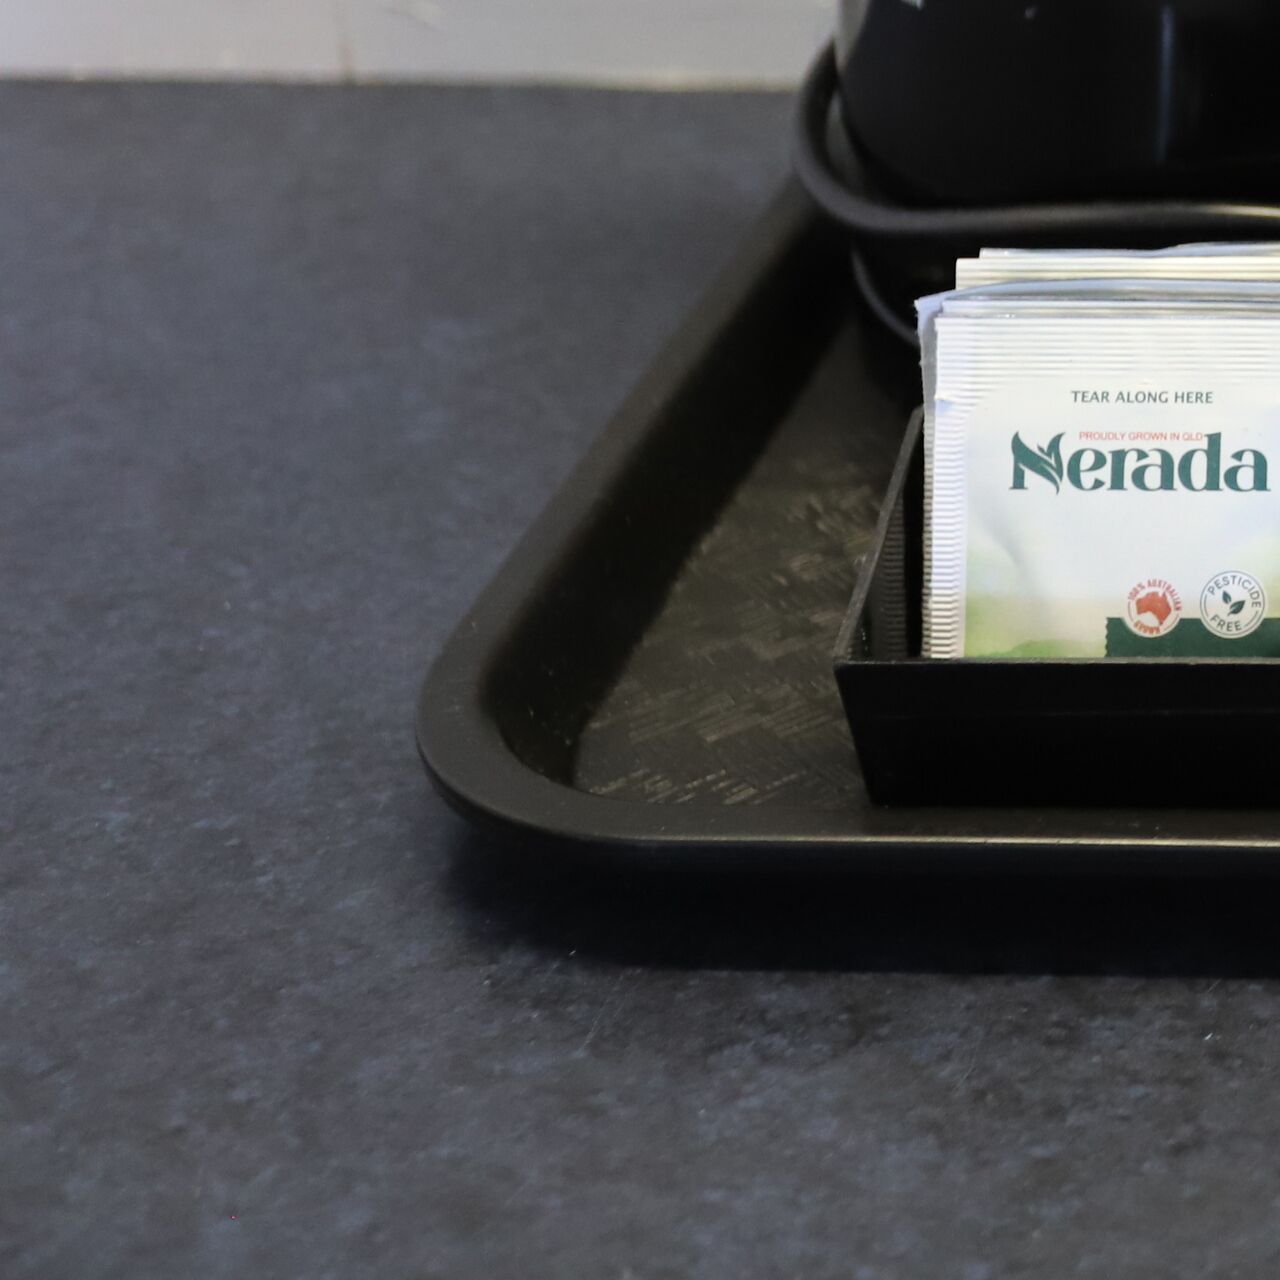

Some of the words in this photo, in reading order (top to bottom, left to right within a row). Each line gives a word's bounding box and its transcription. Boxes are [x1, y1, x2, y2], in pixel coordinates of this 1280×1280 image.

[1070, 390, 1111, 405] TEAR
[1115, 390, 1169, 406] ALONG
[1173, 390, 1214, 405] HERE
[1078, 431, 1126, 442] PROUDLY
[1128, 431, 1168, 442] GROWN
[1169, 431, 1180, 442] IN
[1181, 431, 1204, 443] QLD
[1008, 431, 1271, 496] Nerada
[1147, 578, 1183, 612] AUSTRALIAN
[1206, 574, 1262, 608] PESTICIDE
[1209, 613, 1243, 632] FREE
